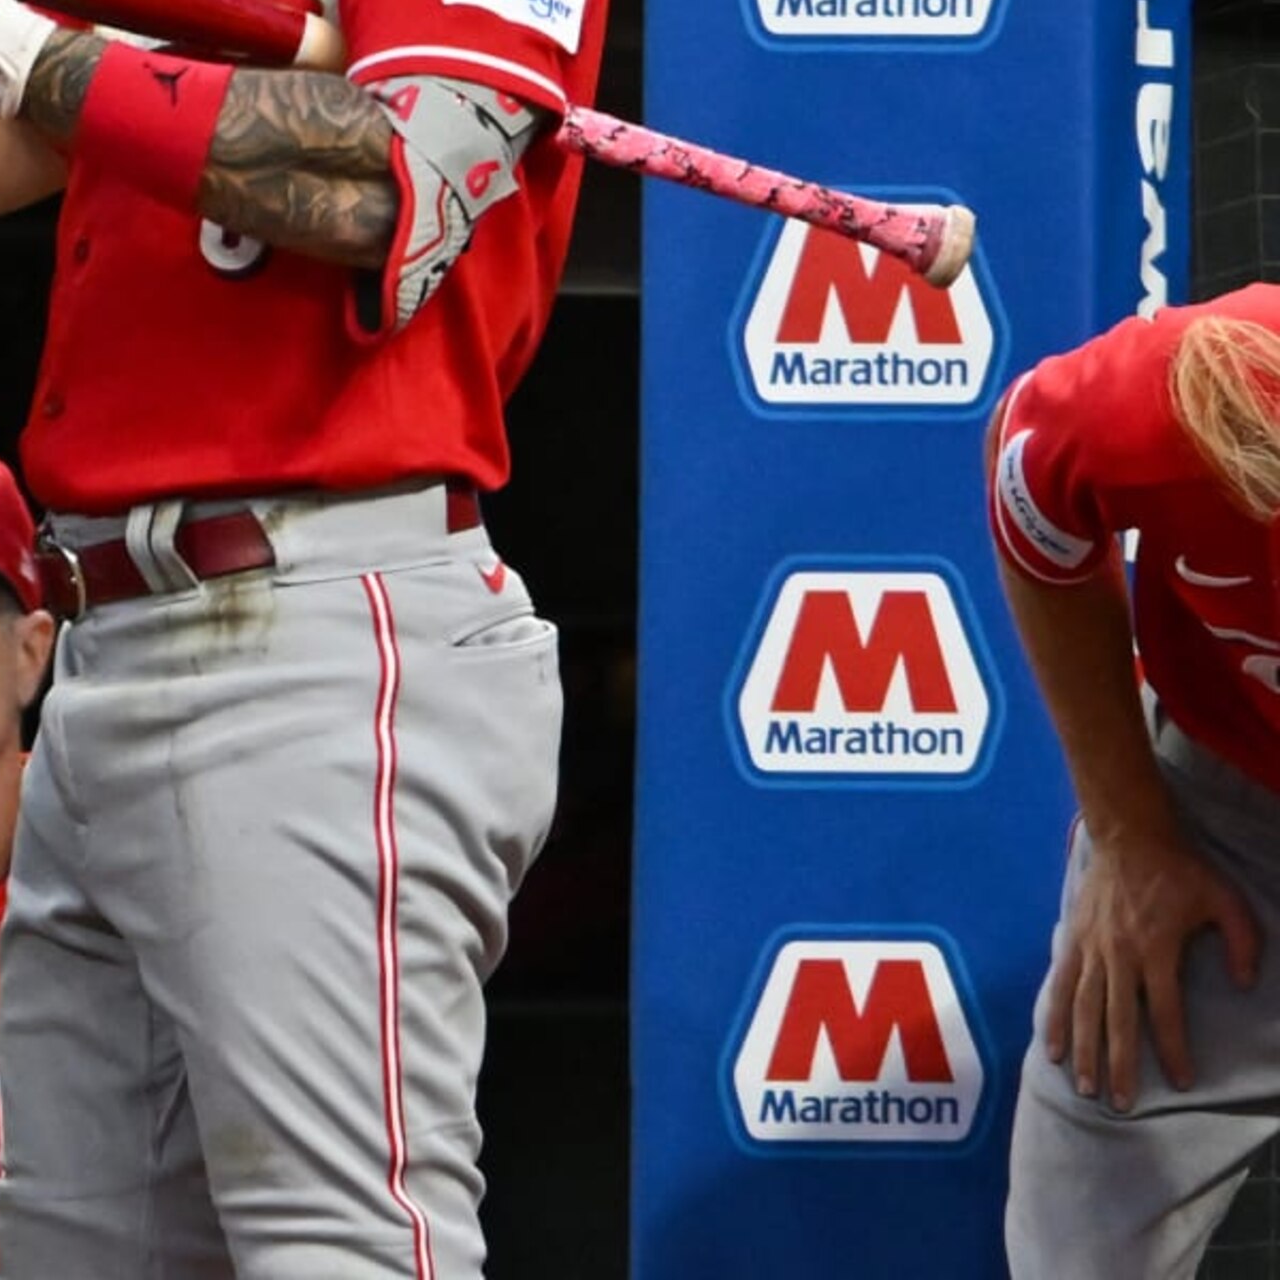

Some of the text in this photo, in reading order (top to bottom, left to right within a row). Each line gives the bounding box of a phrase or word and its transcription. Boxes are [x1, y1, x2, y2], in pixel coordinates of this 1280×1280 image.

[769, 352, 968, 386] Marathon
[764, 720, 964, 755] Marathon
[759, 1089, 959, 1124] Marathon
